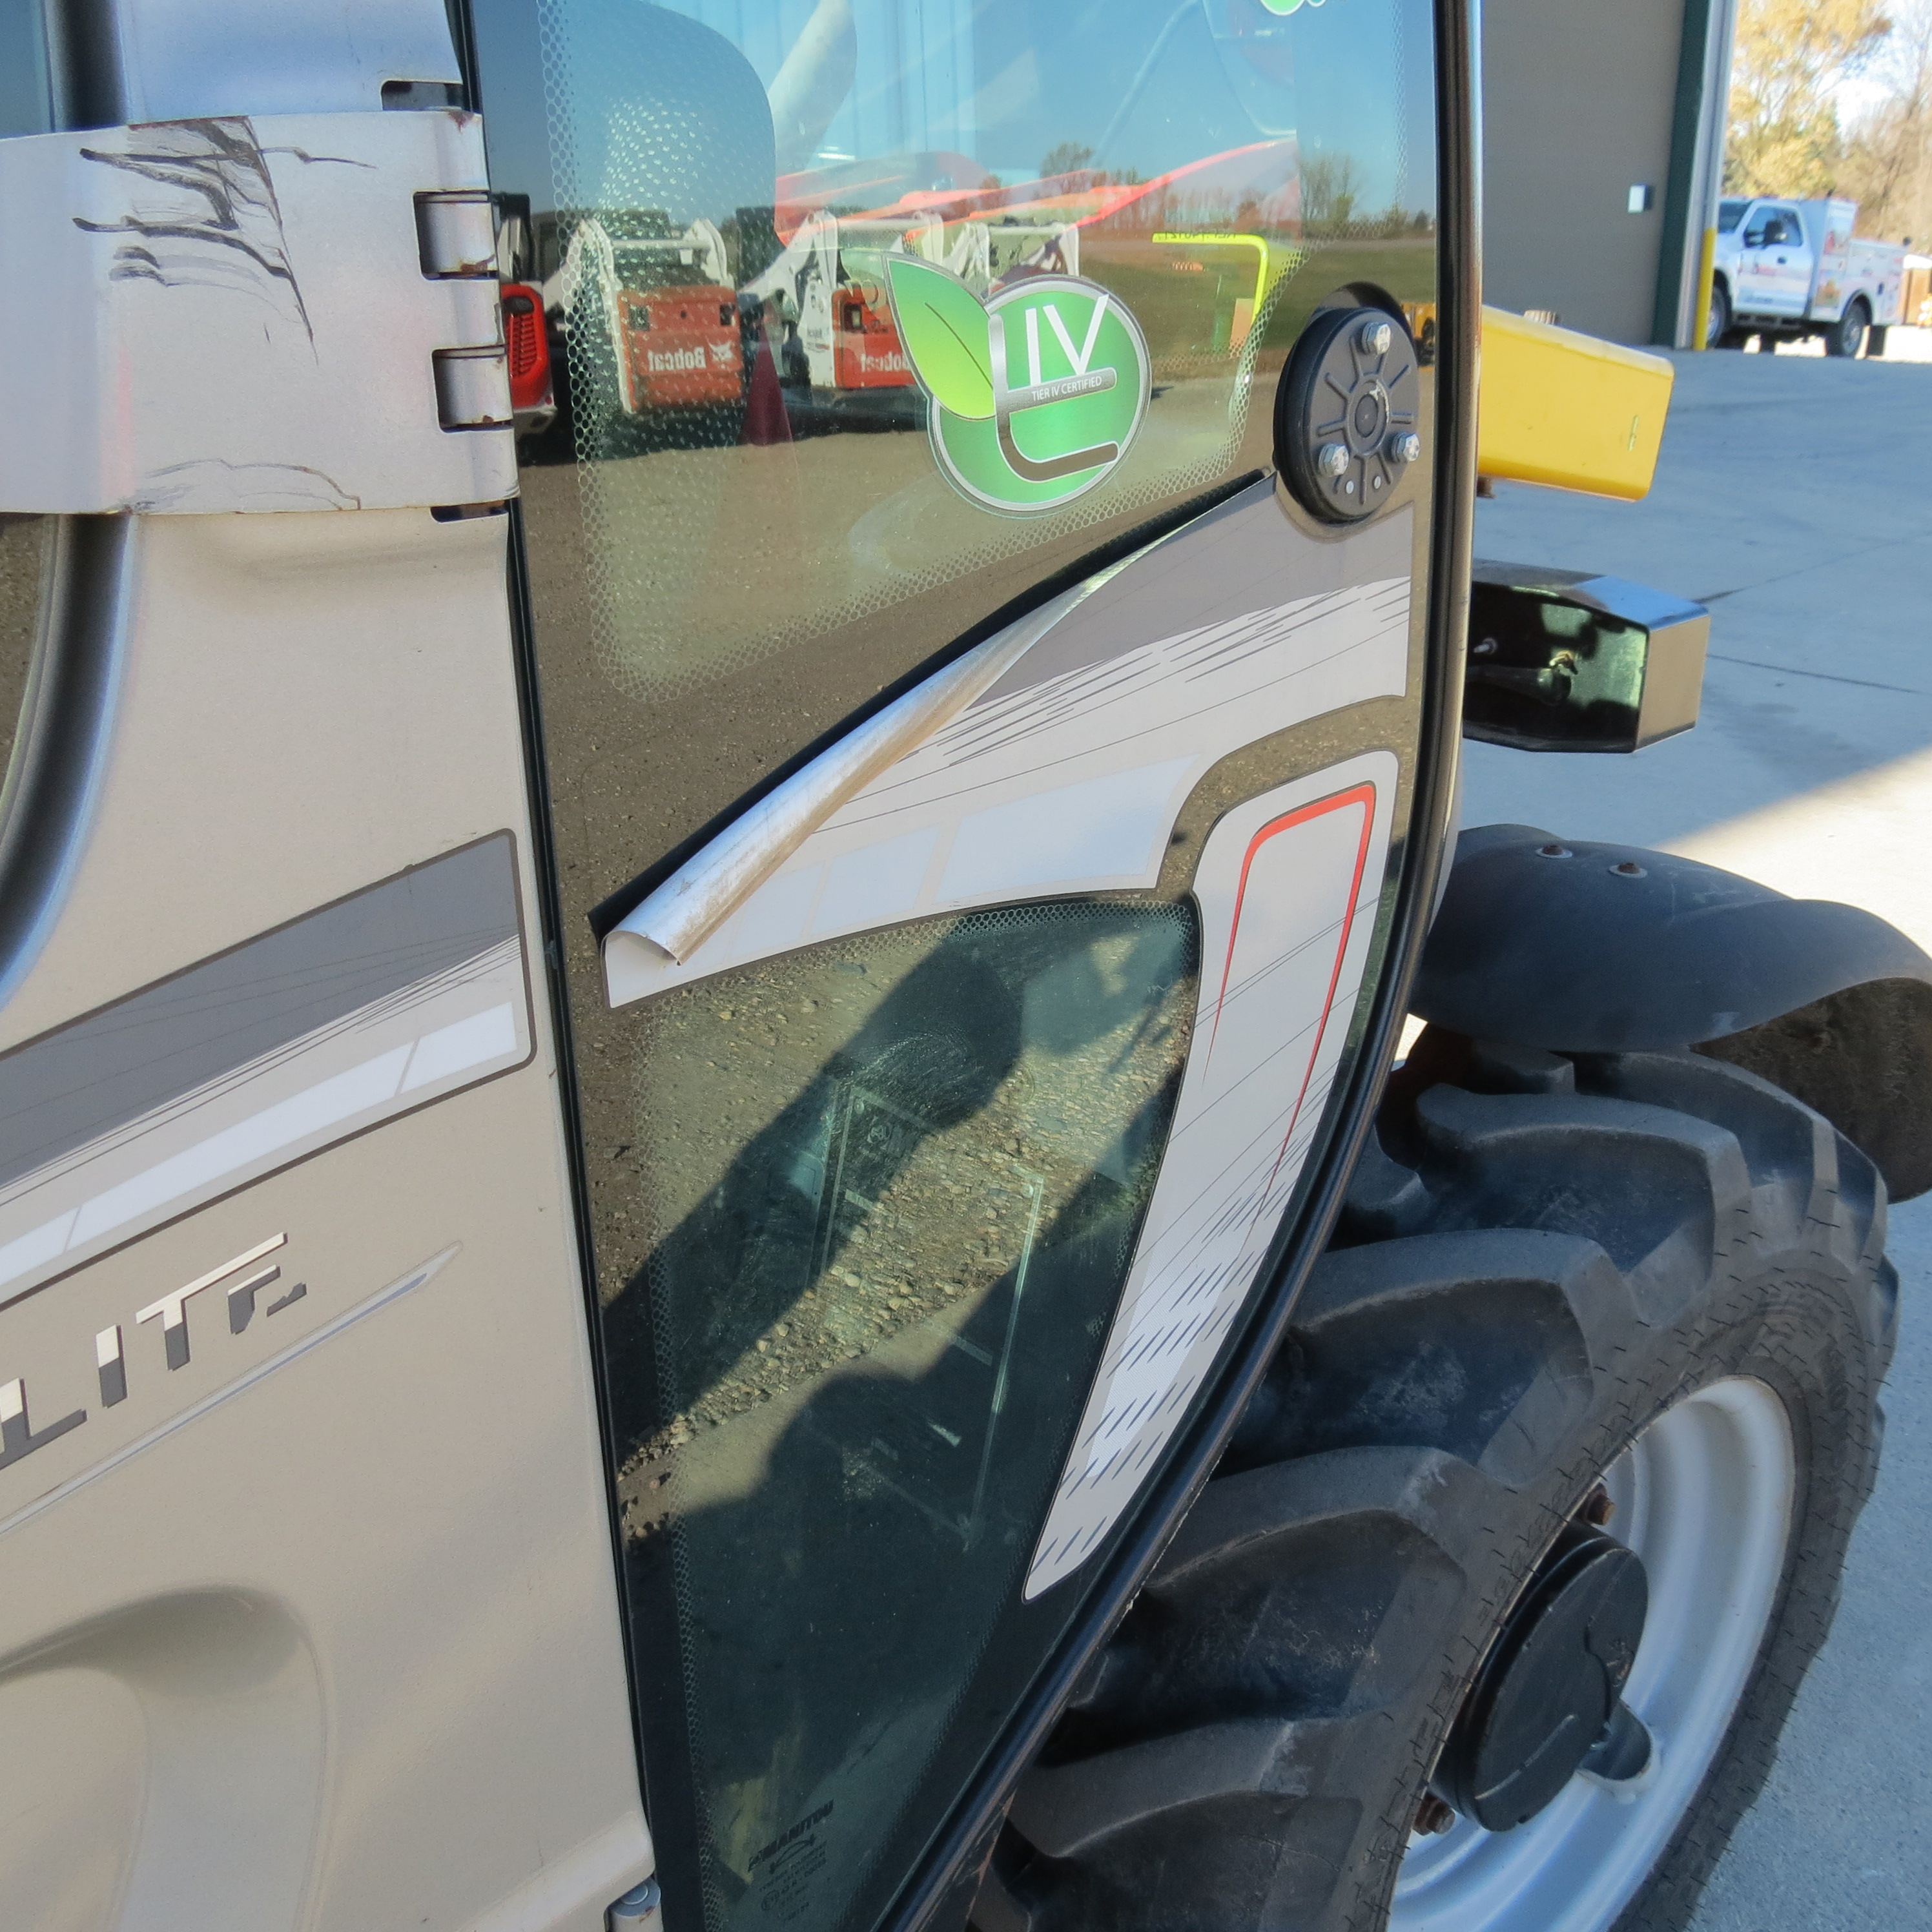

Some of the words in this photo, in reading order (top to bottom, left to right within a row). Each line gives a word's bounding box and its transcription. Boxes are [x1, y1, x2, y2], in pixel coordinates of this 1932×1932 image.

[1025, 293, 1109, 387] IV
[1032, 387, 1051, 402] TIER
[1051, 385, 1060, 397] IV
[1061, 376, 1103, 395] CERTIFIED
